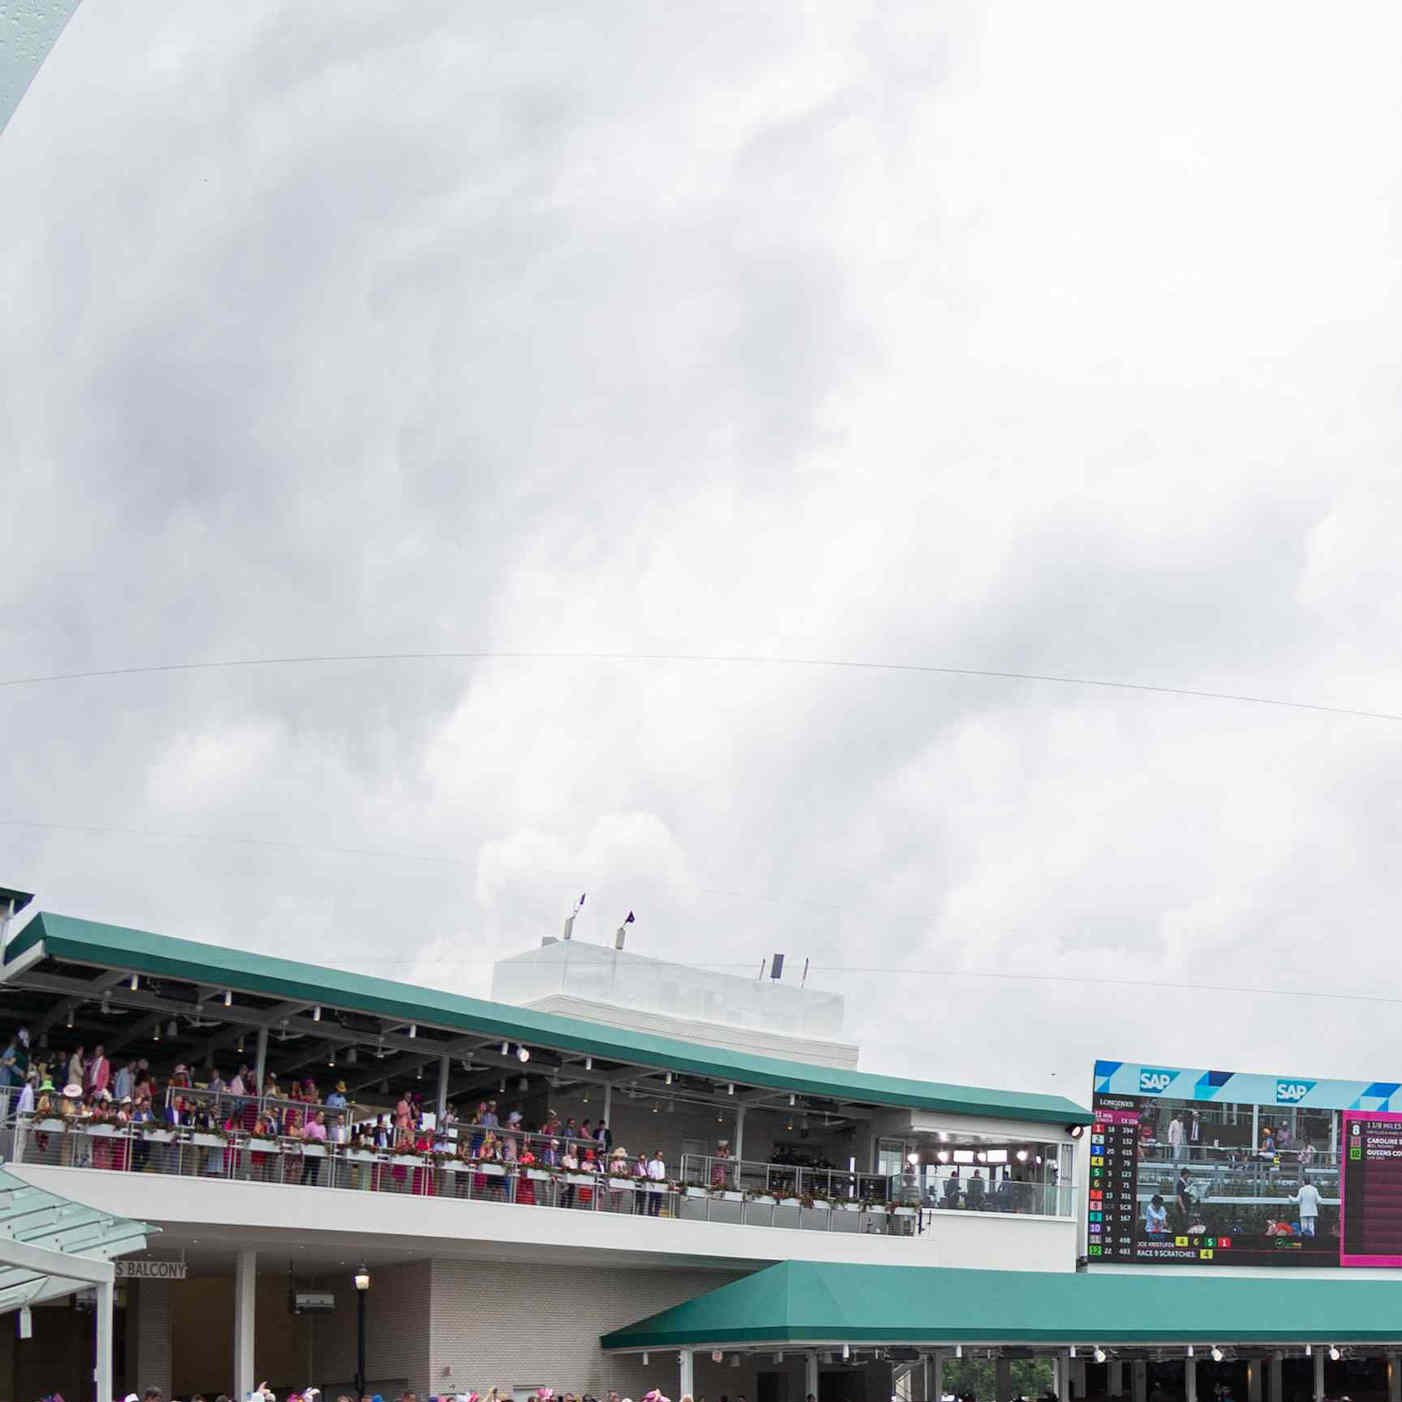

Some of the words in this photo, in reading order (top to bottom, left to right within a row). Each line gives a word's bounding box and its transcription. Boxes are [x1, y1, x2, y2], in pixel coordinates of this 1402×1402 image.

[1140, 1072, 1170, 1091] SAP
[1277, 1083, 1307, 1100] SAP
[1352, 1124, 1360, 1136] 8
[1367, 1137, 1398, 1145] CAROLINE
[1090, 1224, 1101, 1232] 10
[128, 1262, 185, 1277] BALCONY
